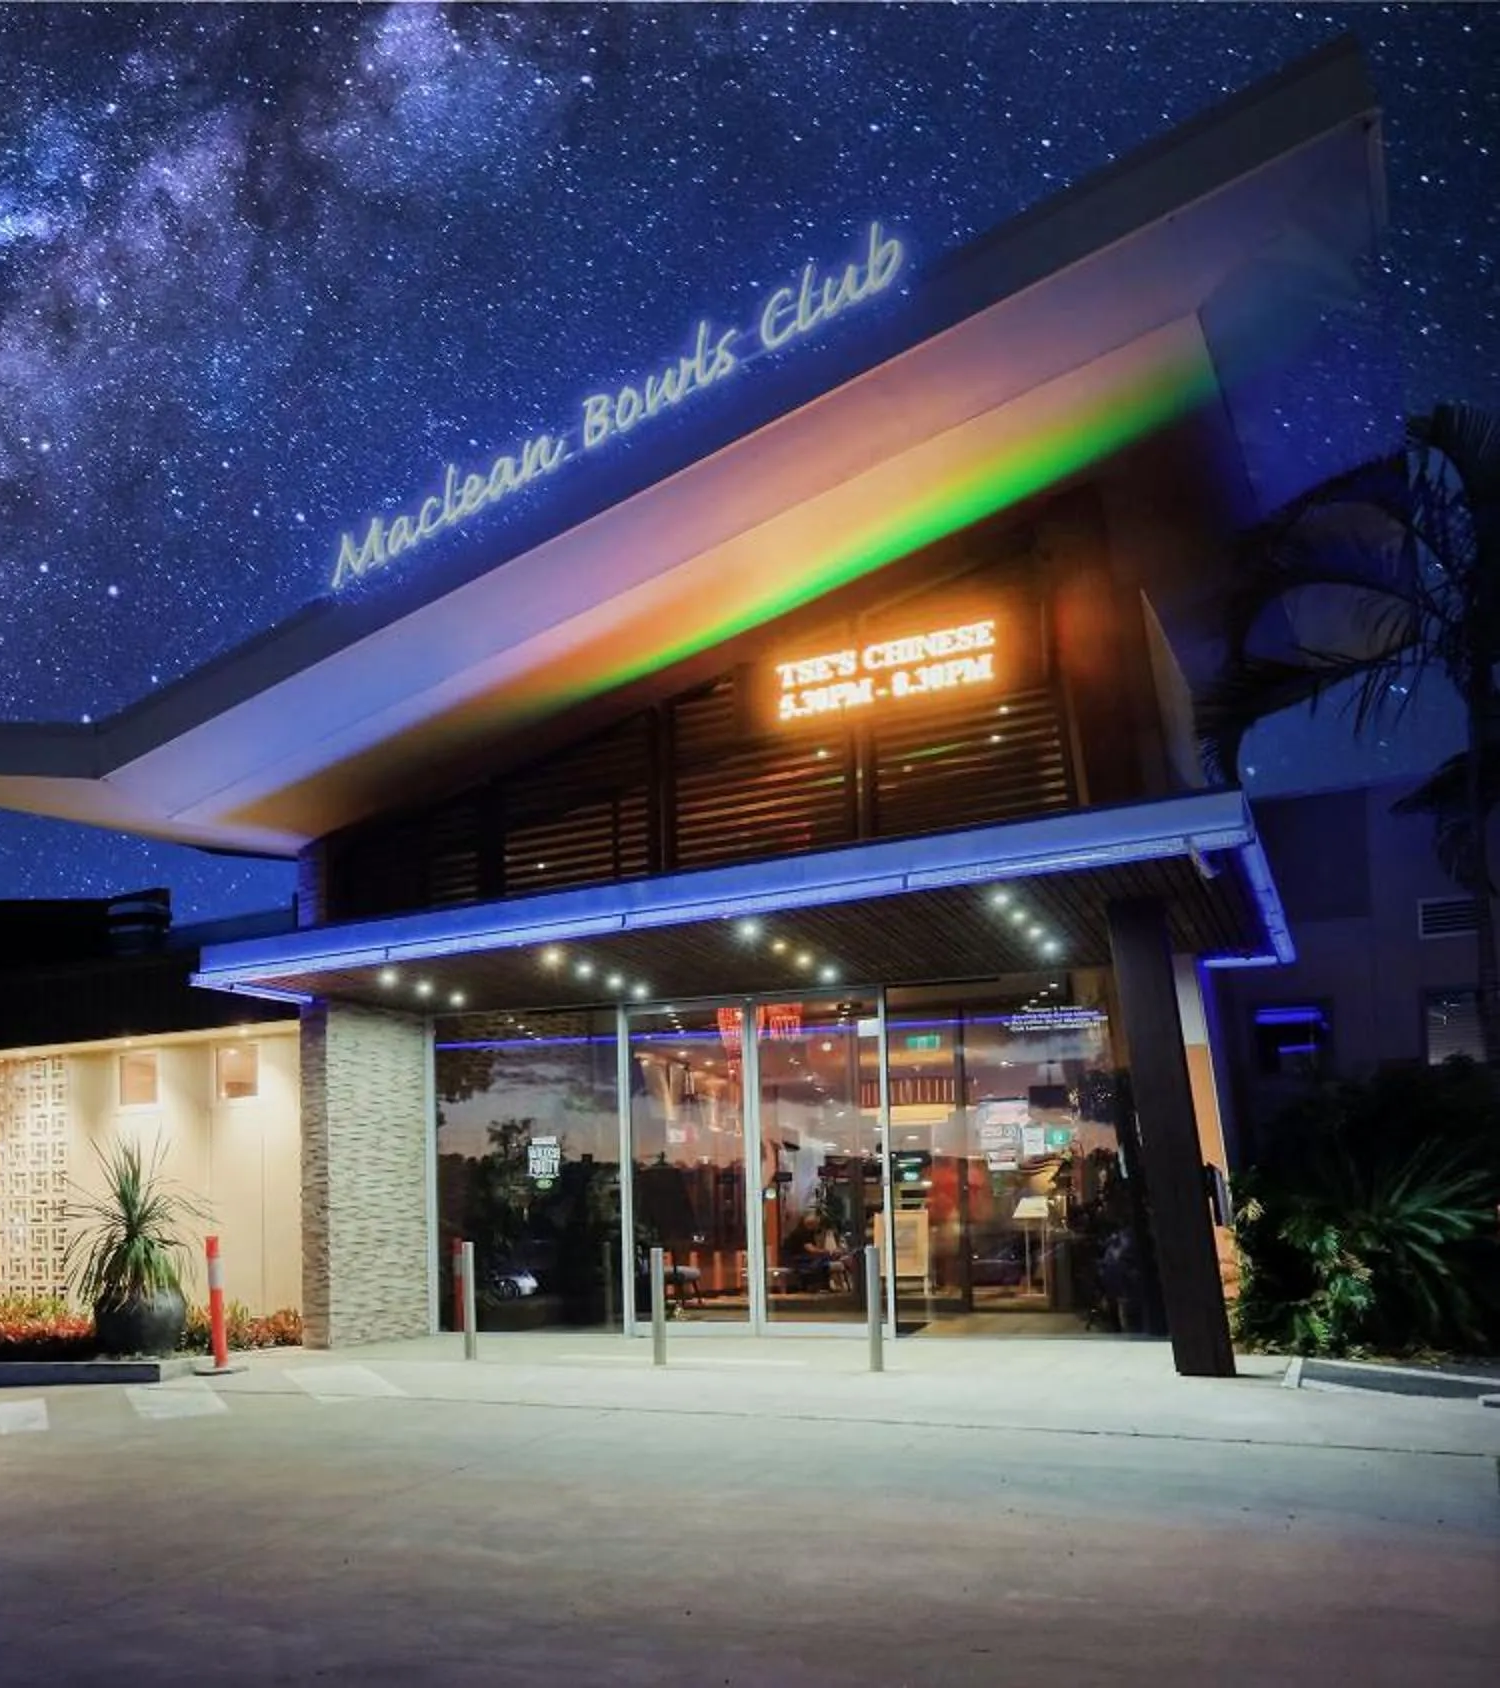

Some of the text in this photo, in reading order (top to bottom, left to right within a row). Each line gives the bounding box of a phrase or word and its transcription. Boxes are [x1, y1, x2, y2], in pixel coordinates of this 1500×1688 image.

[331, 222, 902, 588] Maclean Bowls Club
[775, 619, 995, 688] TSE'S CHINESE
